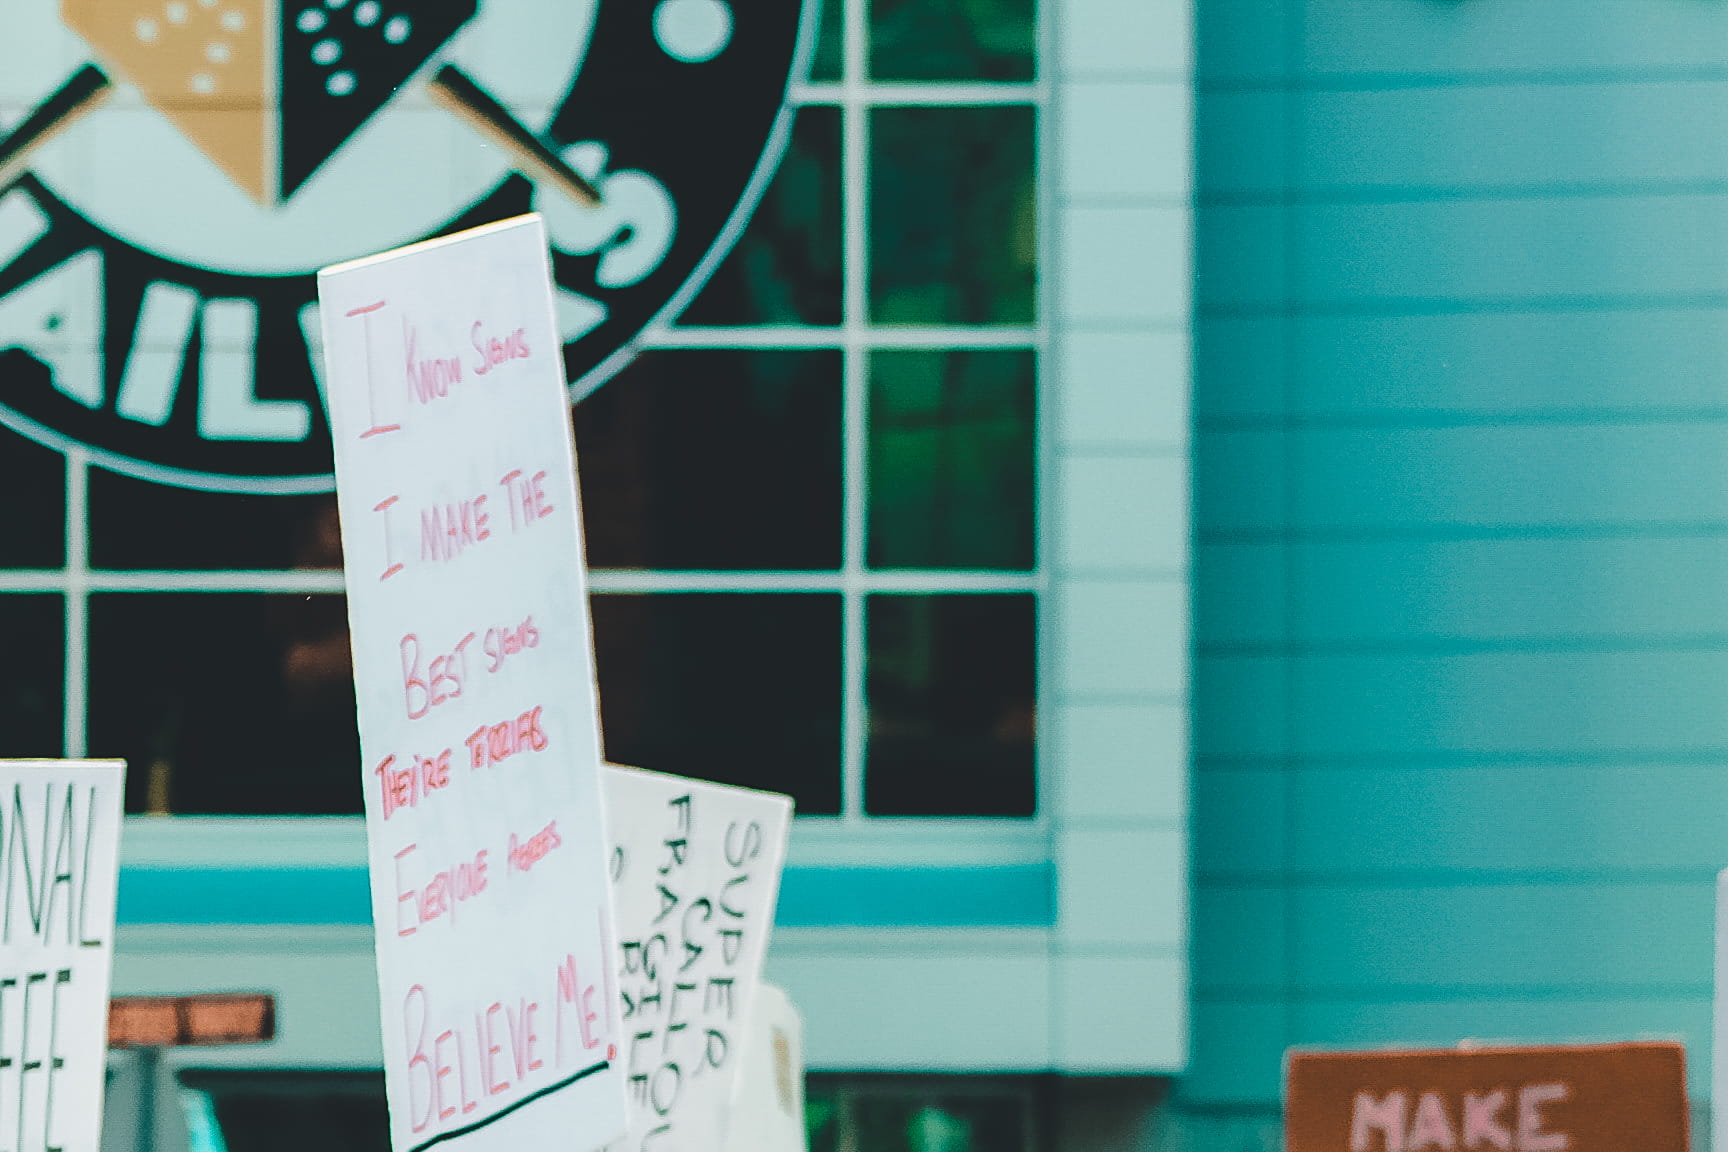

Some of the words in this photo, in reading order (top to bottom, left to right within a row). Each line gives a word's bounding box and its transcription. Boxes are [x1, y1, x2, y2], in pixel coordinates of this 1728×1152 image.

[346, 300, 400, 438] I
[401, 311, 462, 404] KNOW
[373, 495, 404, 582] I
[420, 494, 490, 563] MAKE
[500, 469, 554, 535] THE
[399, 632, 475, 719] BEST
[404, 983, 543, 1134] BELIEVE
[556, 904, 617, 1069] ME!
[693, 821, 761, 1079] SUPER
